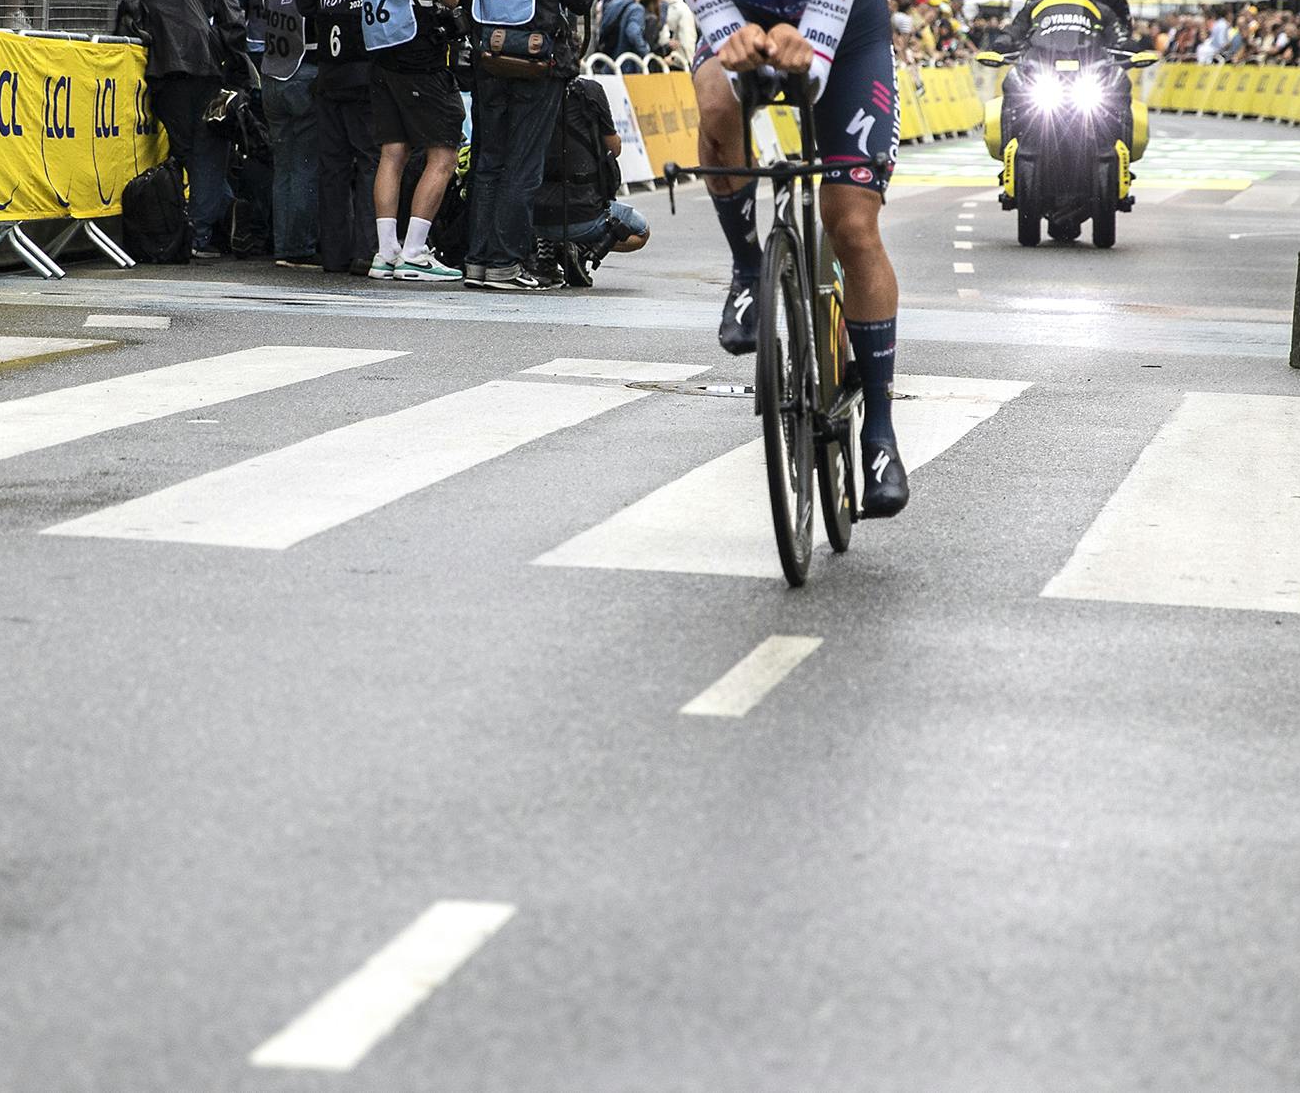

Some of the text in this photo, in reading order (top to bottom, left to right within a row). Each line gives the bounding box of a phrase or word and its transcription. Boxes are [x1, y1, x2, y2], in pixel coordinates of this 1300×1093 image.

[330, 24, 341, 57] 6
[1051, 13, 1091, 29] YAMAHA
[44, 75, 76, 139] LCL
[94, 77, 120, 138] LCL
